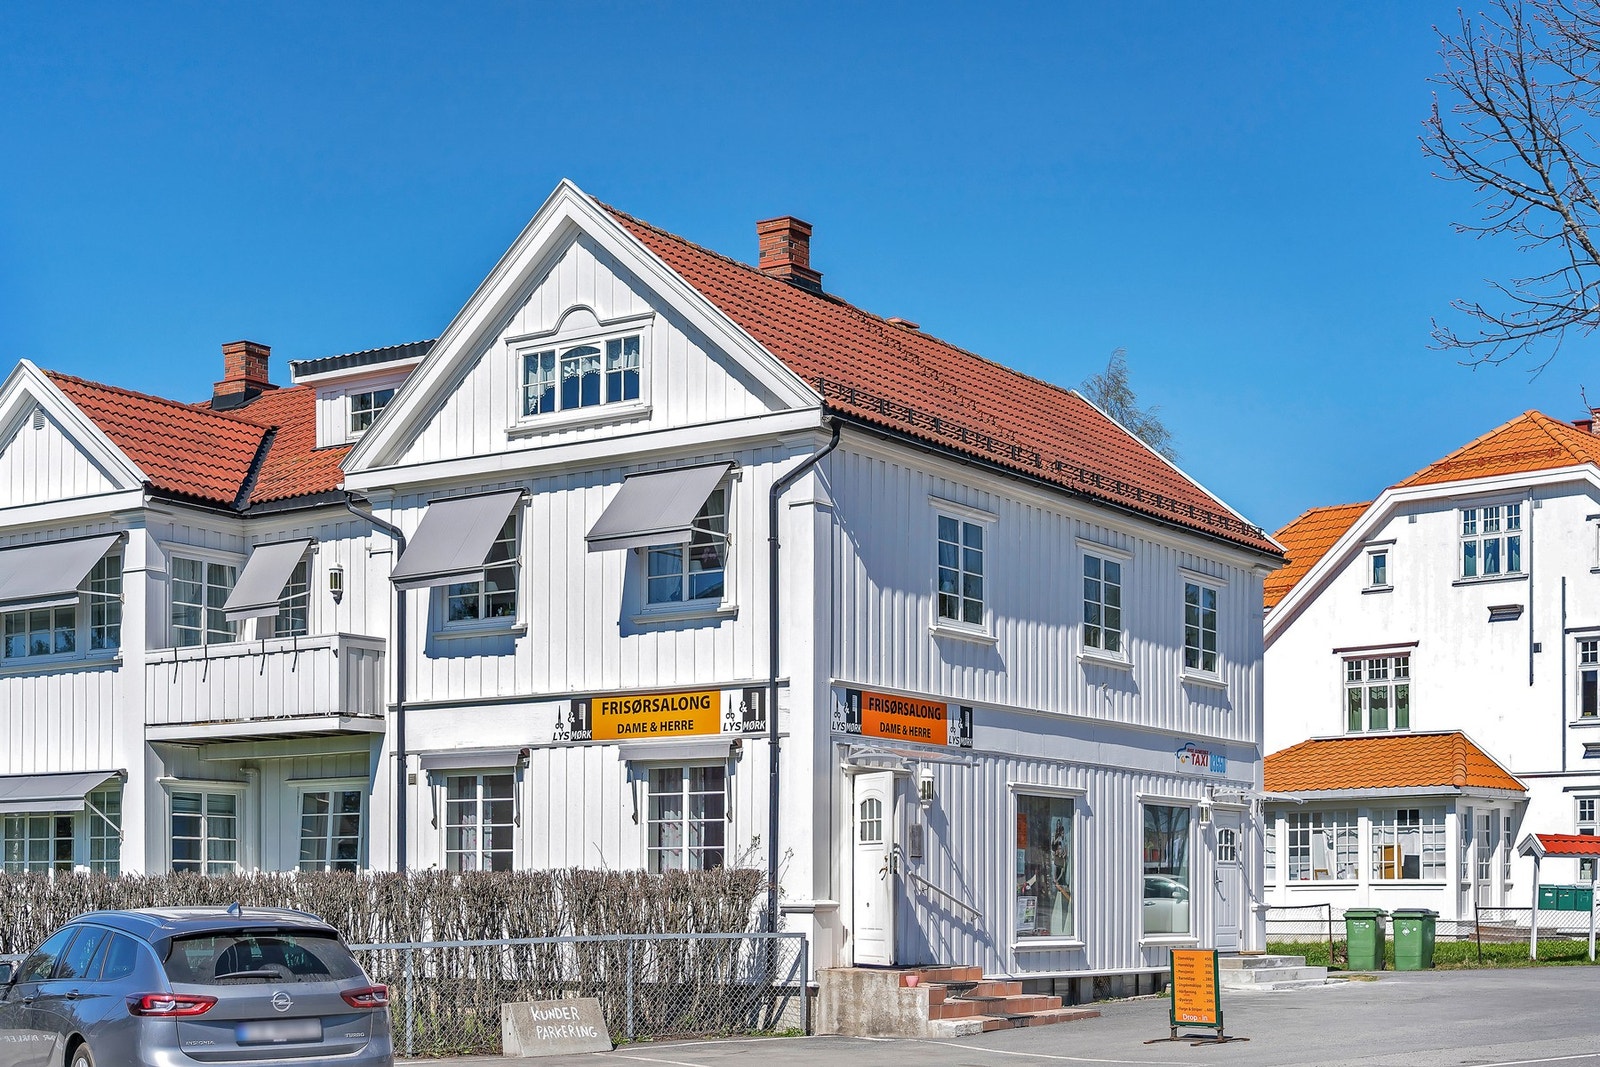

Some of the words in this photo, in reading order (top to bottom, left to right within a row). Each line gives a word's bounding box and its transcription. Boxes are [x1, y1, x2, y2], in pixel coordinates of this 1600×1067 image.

[601, 695, 711, 716] FRISØRSALONG
[868, 697, 941, 721] FRISØRSALONG
[617, 721, 648, 734] DAME
[649, 722, 658, 732] &
[660, 719, 694, 732] HERRE
[723, 721, 742, 732] LYS
[743, 720, 766, 731] MØRK
[832, 720, 846, 731] LYS
[880, 721, 902, 734] DAME
[902, 725, 908, 735] &
[908, 726, 931, 738] HERRE
[552, 732, 570, 741] LYS
[570, 729, 592, 740] MØRK
[948, 735, 960, 745] LYS
[1191, 753, 1209, 767] TAXI
[530, 1006, 581, 1021] KUNDER
[536, 1025, 598, 1040] PARKERING
